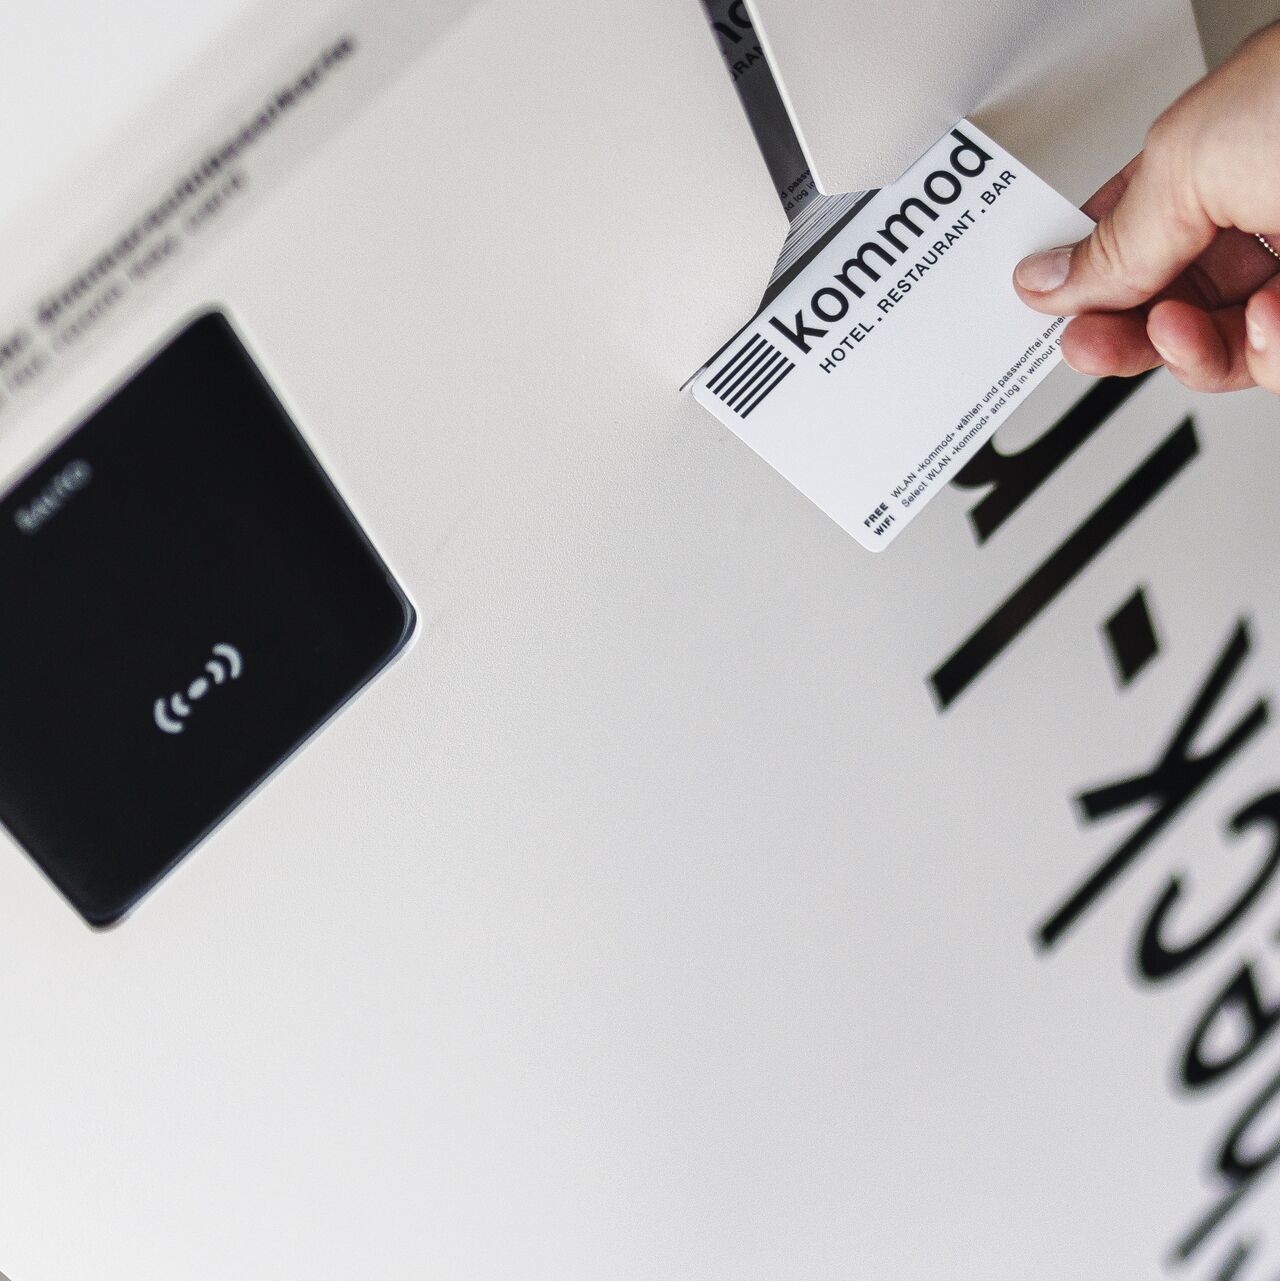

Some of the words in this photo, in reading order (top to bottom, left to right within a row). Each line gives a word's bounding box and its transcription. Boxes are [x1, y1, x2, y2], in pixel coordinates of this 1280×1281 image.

[769, 129, 993, 354] kommod
[820, 324, 874, 373] HOTEL
[877, 210, 975, 313] RESTAURANT
[980, 170, 1017, 206] BAR
[890, 472, 917, 499] WLAN
[955, 402, 984, 431] wählen
[982, 385, 999, 403] und
[997, 337, 1043, 388] passwortfrei
[901, 481, 928, 508] Select
[925, 455, 952, 481] WLAN
[990, 397, 1006, 415] and
[1004, 382, 1021, 398] log
[1018, 375, 1028, 385] in
[1026, 345, 1056, 375] without
[864, 502, 889, 528] FREE
[874, 515, 895, 536] WIFI
